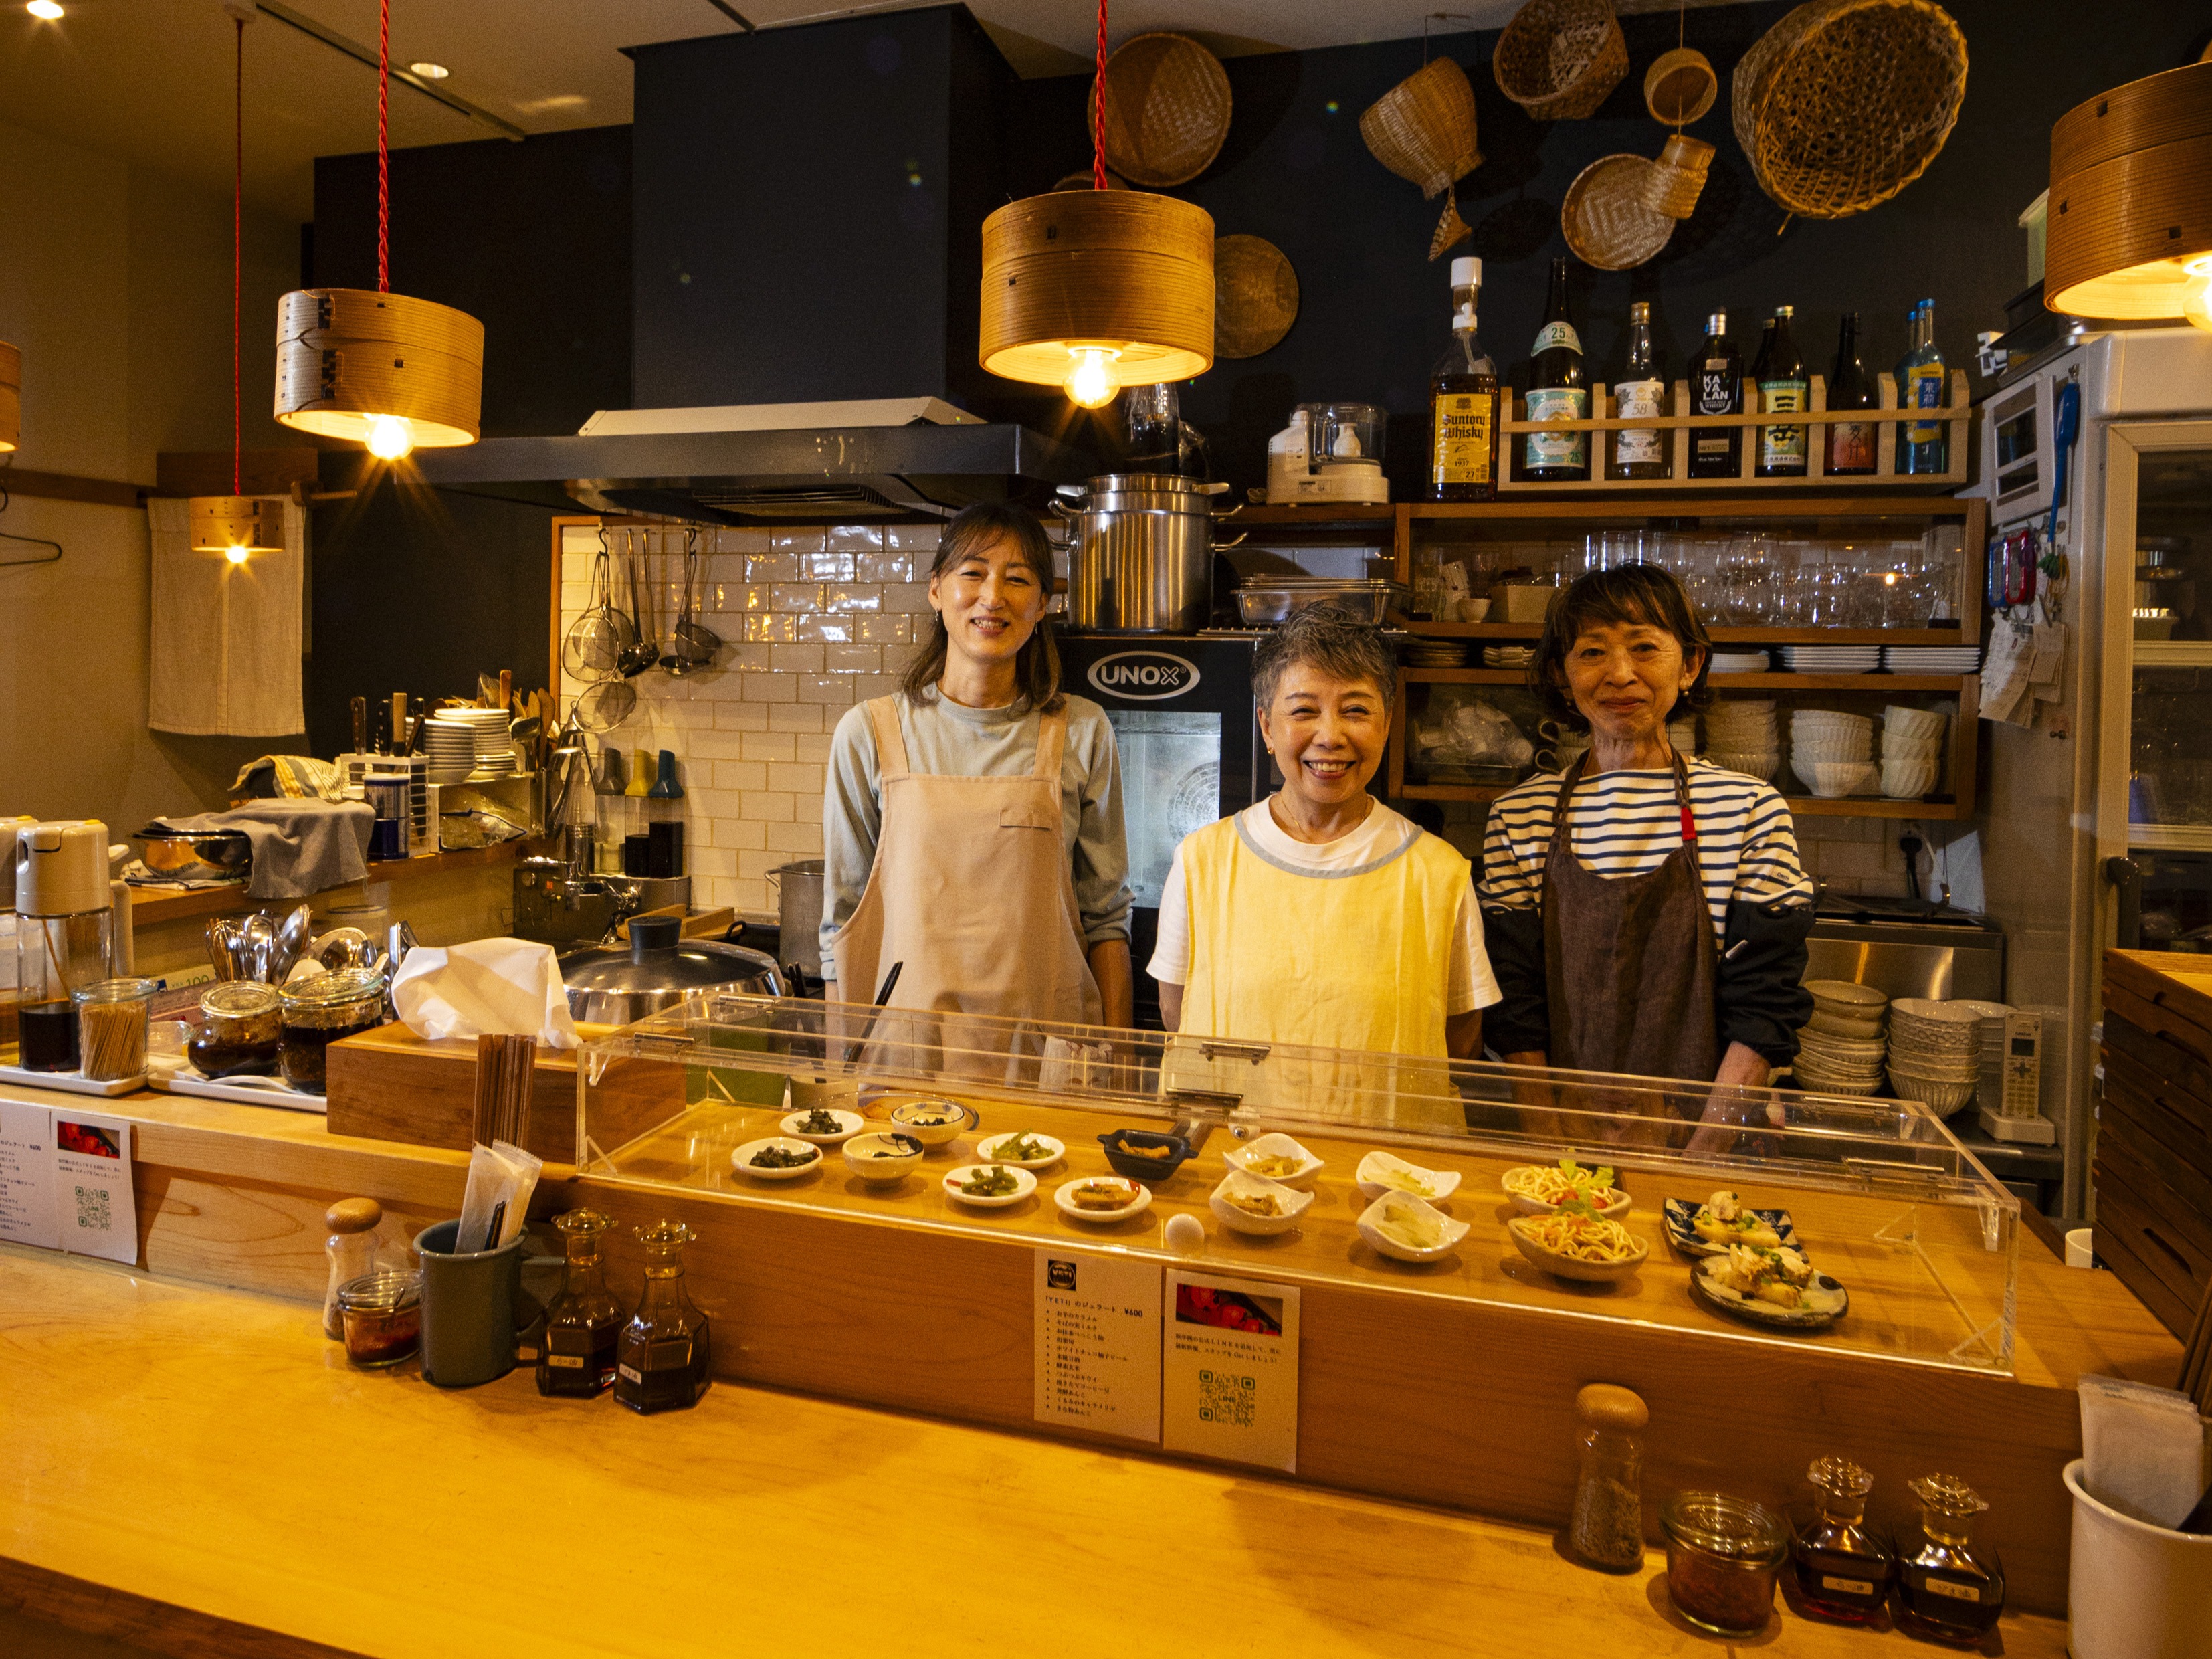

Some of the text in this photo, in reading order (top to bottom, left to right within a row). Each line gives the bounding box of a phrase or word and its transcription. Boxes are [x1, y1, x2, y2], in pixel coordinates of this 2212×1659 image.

[1551, 327, 1566, 339] 25
[1702, 375, 1721, 385] KA
[1703, 383, 1721, 393] VA
[1702, 391, 1729, 401] LAN
[1923, 381, 1935, 409] 茉莉
[1631, 403, 1648, 415] 58
[1442, 414, 1485, 426] Suntory
[1443, 427, 1484, 440] Whisky
[1570, 451, 1580, 463] 25
[1101, 666, 1179, 686] UNOX
[1124, 1308, 1143, 1318] ¥600
